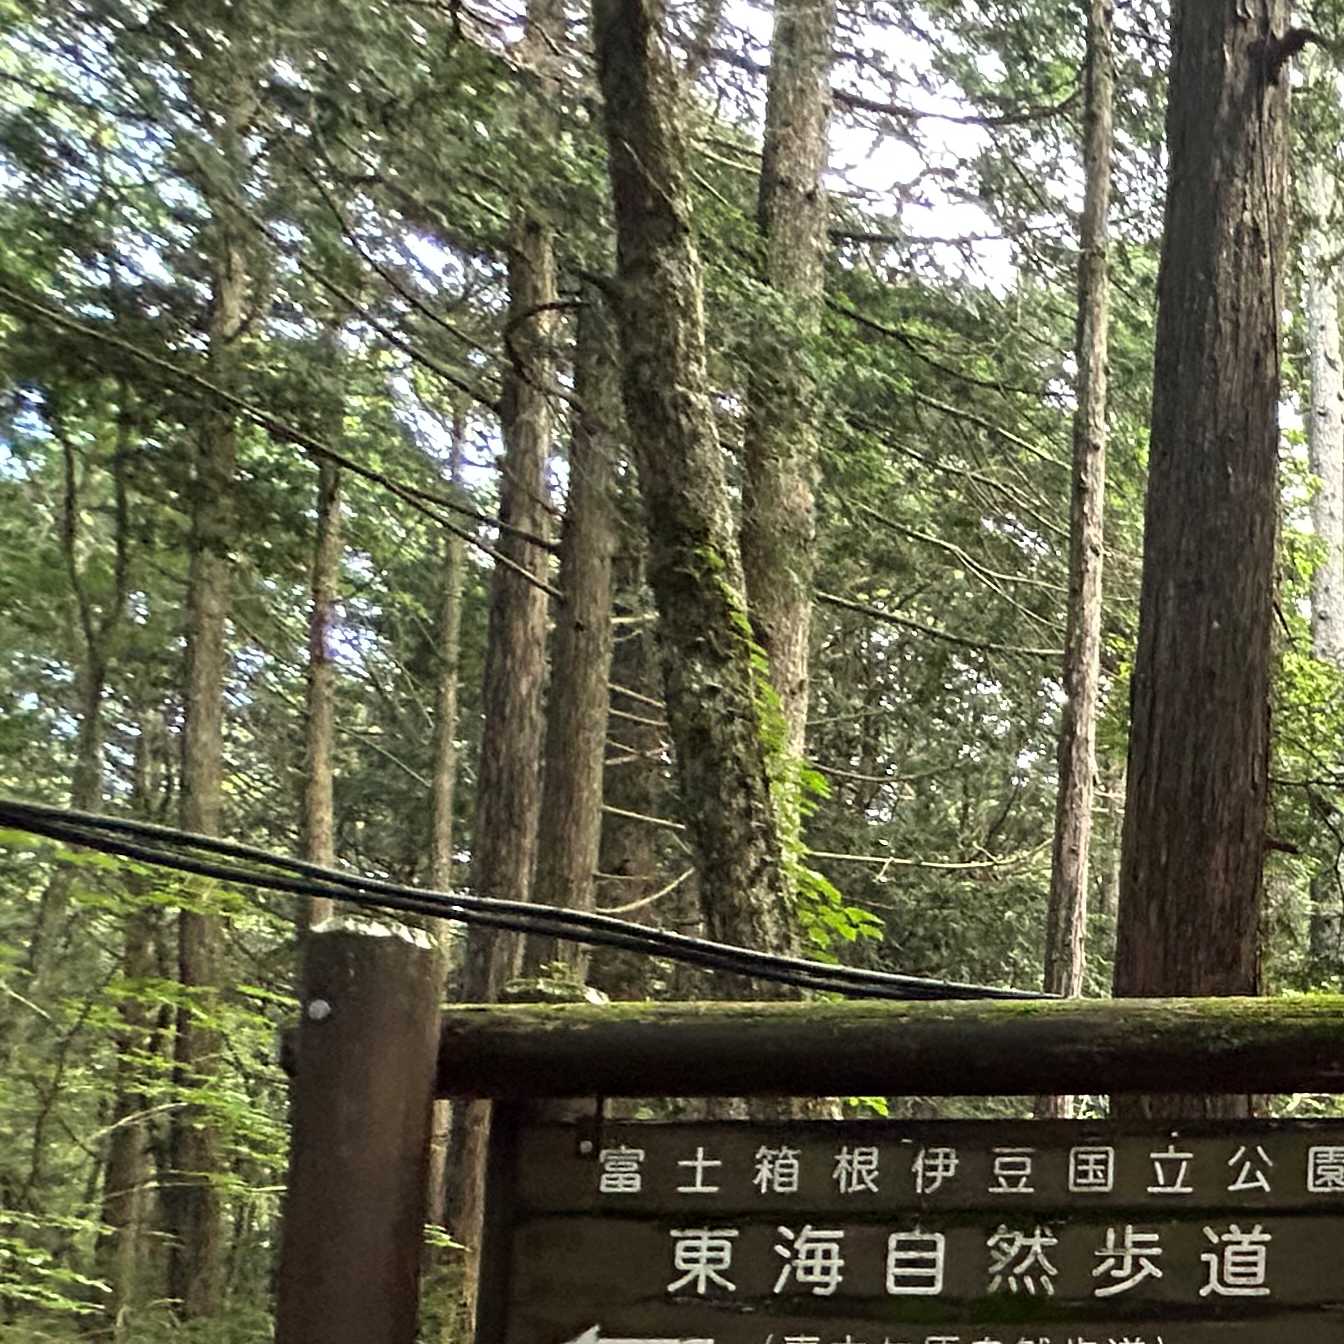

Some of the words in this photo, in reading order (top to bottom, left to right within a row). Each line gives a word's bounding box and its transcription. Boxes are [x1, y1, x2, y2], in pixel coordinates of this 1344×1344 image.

[667, 1222, 1274, 1300] 東海自然歩道
